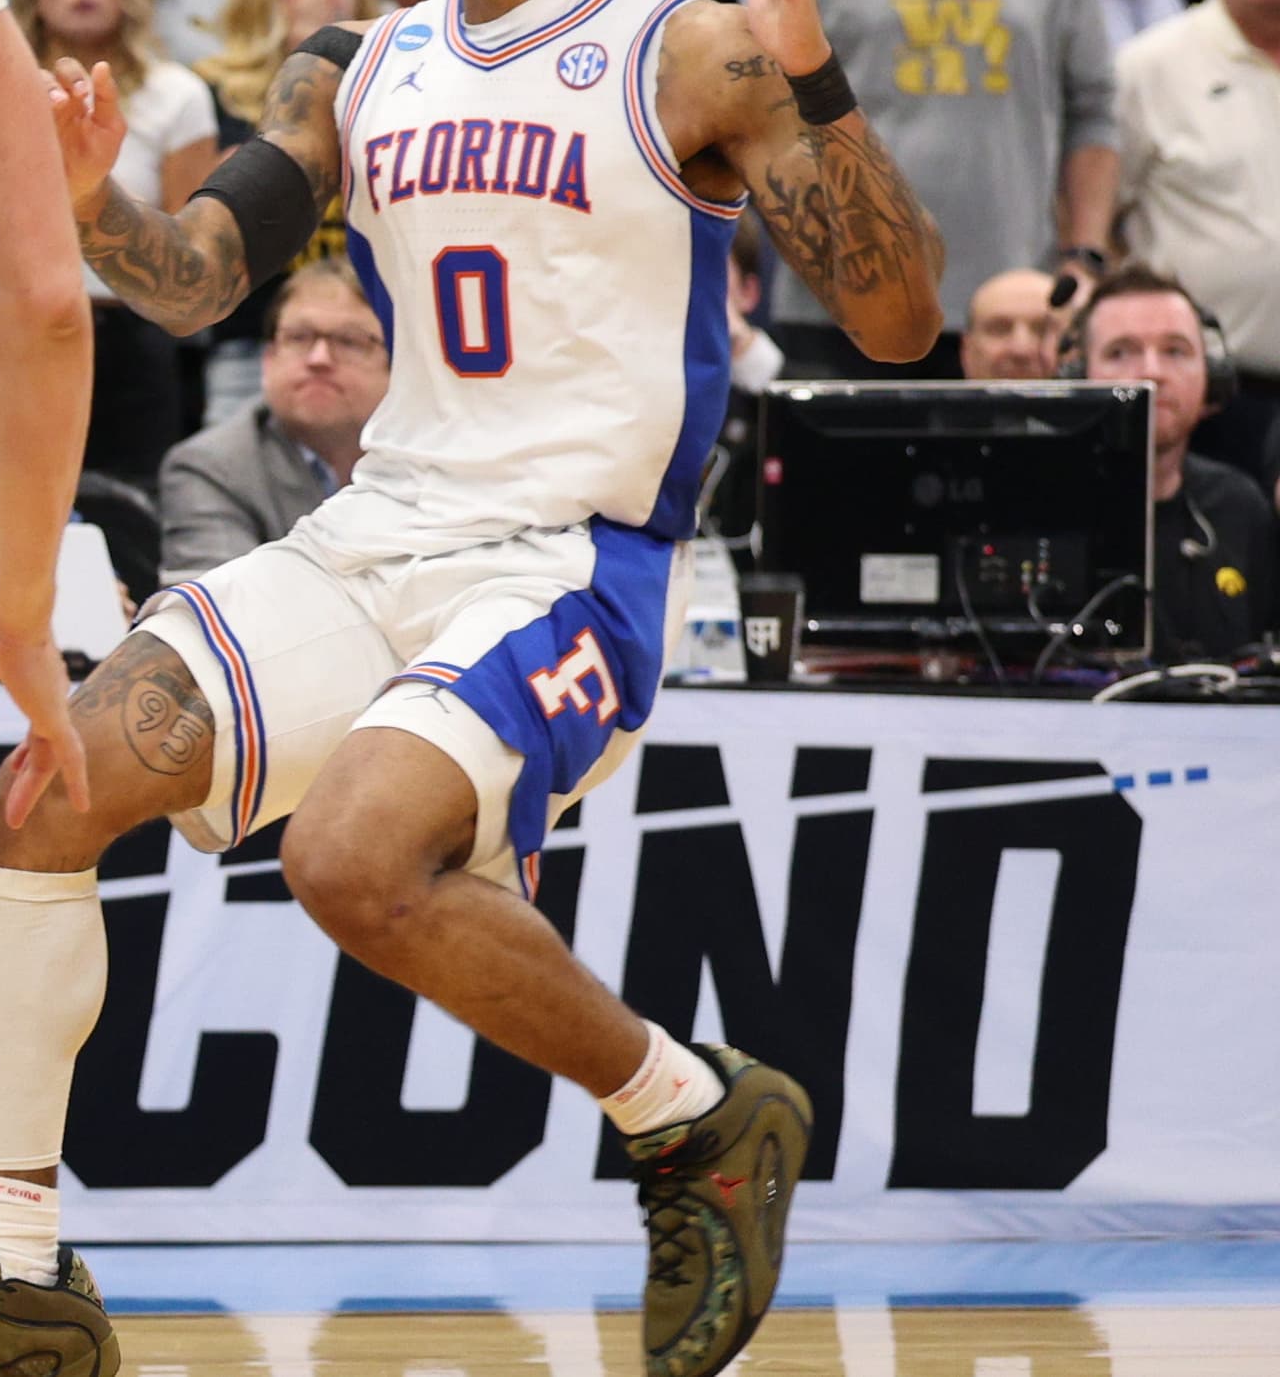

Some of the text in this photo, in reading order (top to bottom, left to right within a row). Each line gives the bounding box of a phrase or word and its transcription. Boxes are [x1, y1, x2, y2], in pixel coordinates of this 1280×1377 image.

[559, 44, 607, 86] SEC
[365, 119, 593, 215] FLORIDA
[431, 243, 514, 379] 0
[526, 625, 622, 727] F
[135, 689, 204, 765] 95
